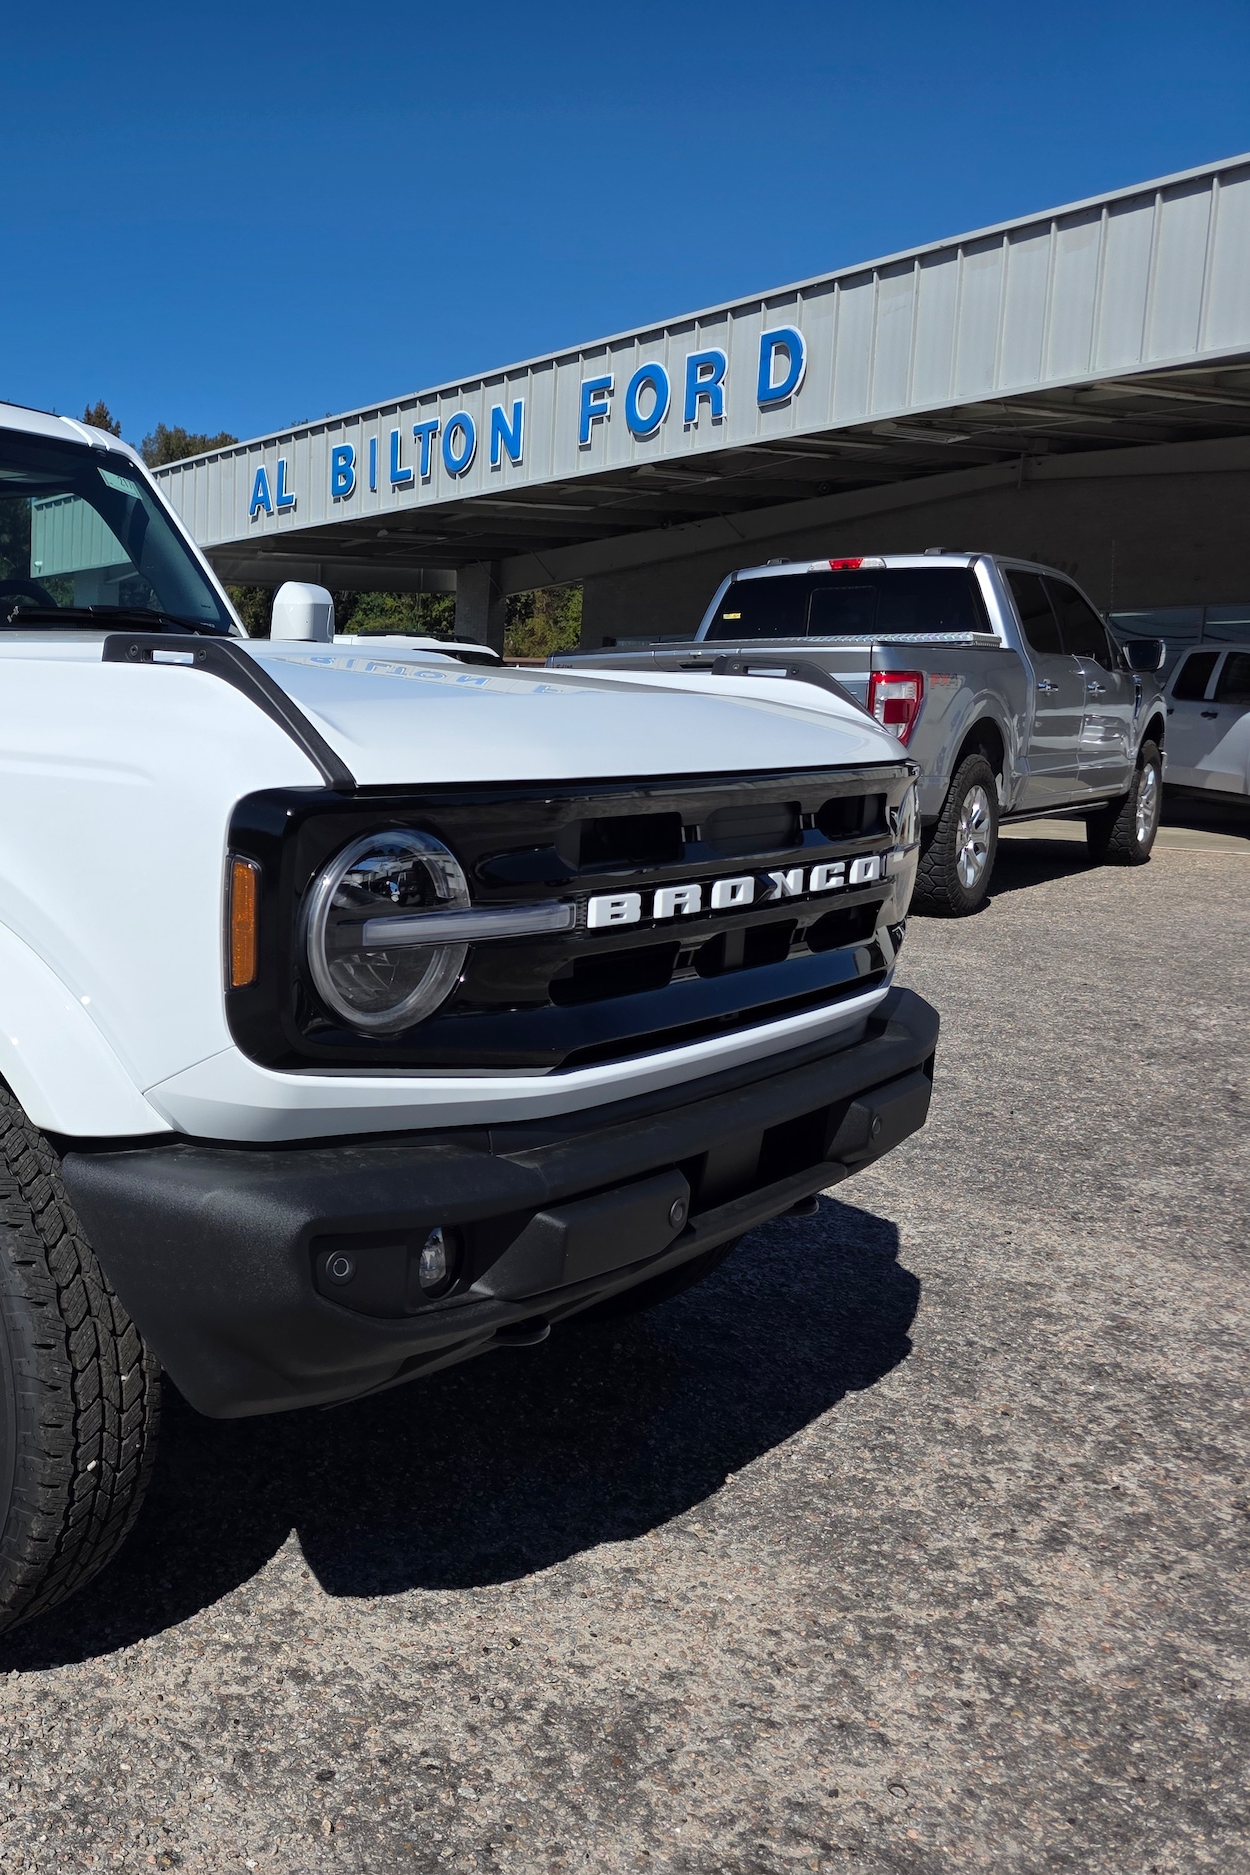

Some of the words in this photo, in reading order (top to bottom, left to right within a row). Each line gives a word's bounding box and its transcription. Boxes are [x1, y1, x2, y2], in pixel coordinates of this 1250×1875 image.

[249, 457, 296, 517] AL
[330, 397, 525, 499] BILTON
[578, 324, 807, 447] FORD
[587, 855, 881, 929] BRONCO
